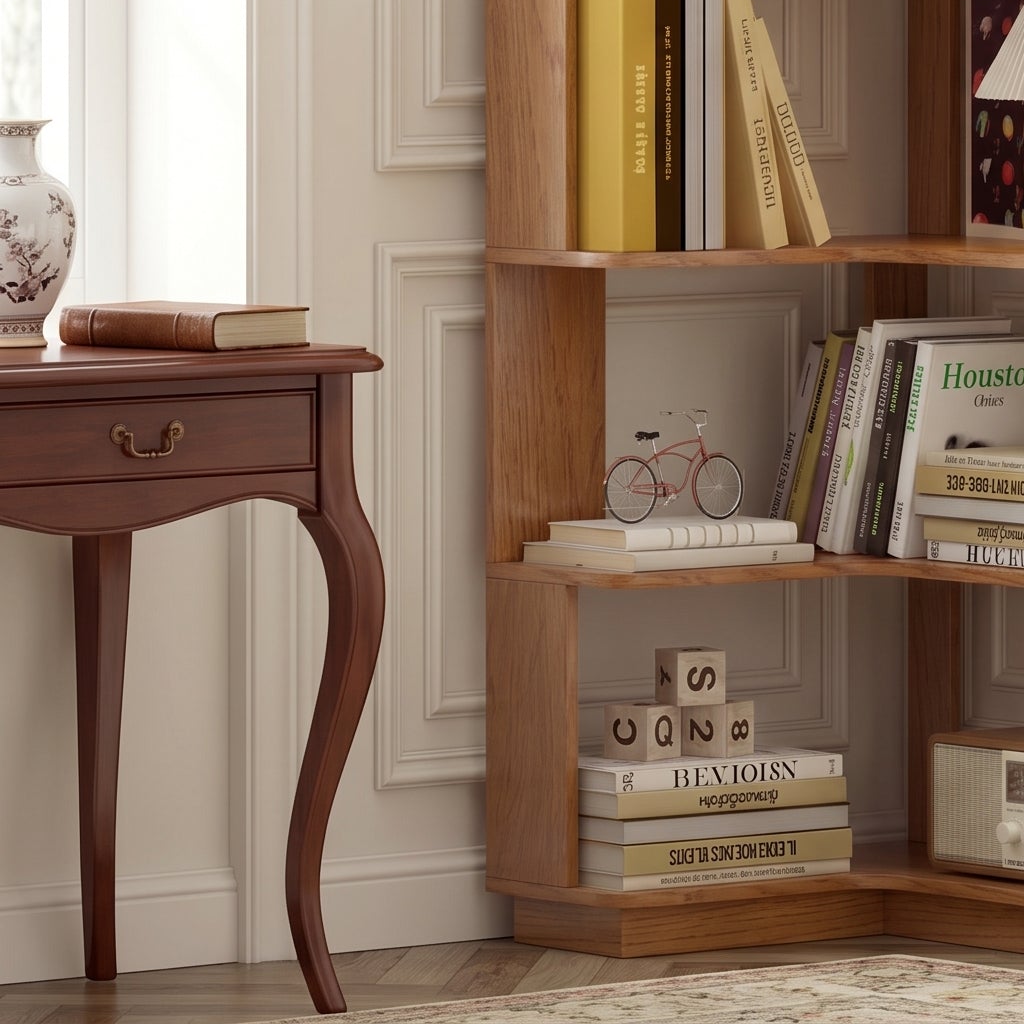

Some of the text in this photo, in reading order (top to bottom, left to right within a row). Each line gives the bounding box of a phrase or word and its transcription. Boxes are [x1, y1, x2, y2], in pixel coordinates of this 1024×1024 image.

[687, 666, 717, 692] S
[612, 718, 637, 746] C
[655, 715, 673, 747] Q
[689, 718, 714, 742] 2
[731, 718, 749, 741] 8
